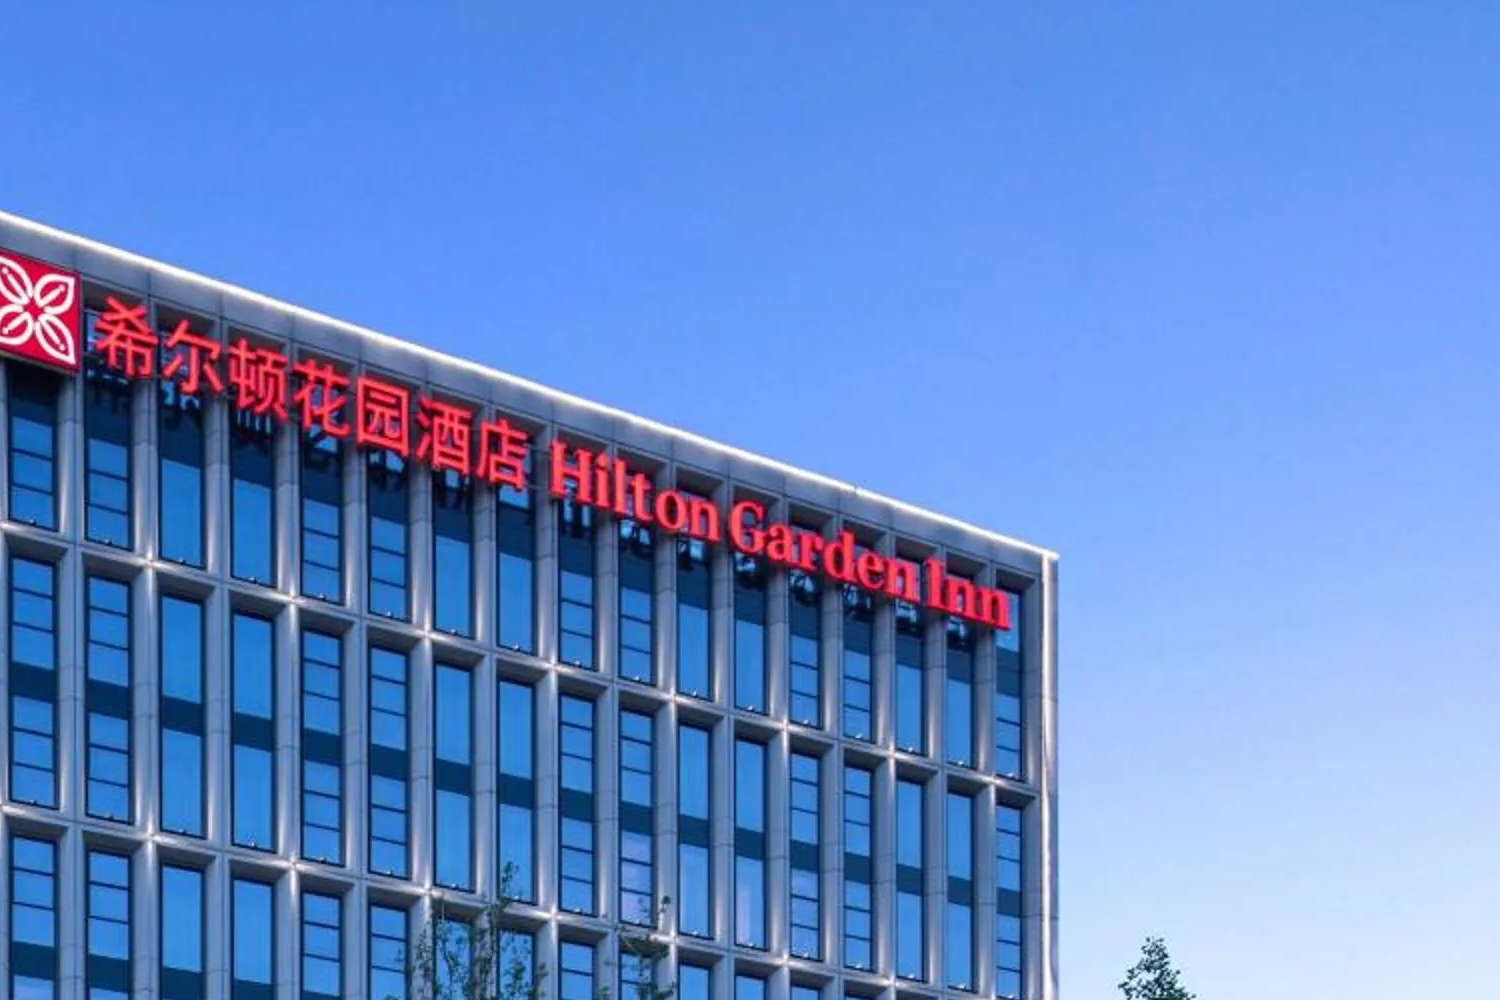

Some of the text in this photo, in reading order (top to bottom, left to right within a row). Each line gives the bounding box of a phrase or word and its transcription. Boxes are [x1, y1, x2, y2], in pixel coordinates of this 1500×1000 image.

[92, 295, 528, 490] 希尔顿花园酒店
[549, 438, 1011, 631] Hilton Garden Inn
